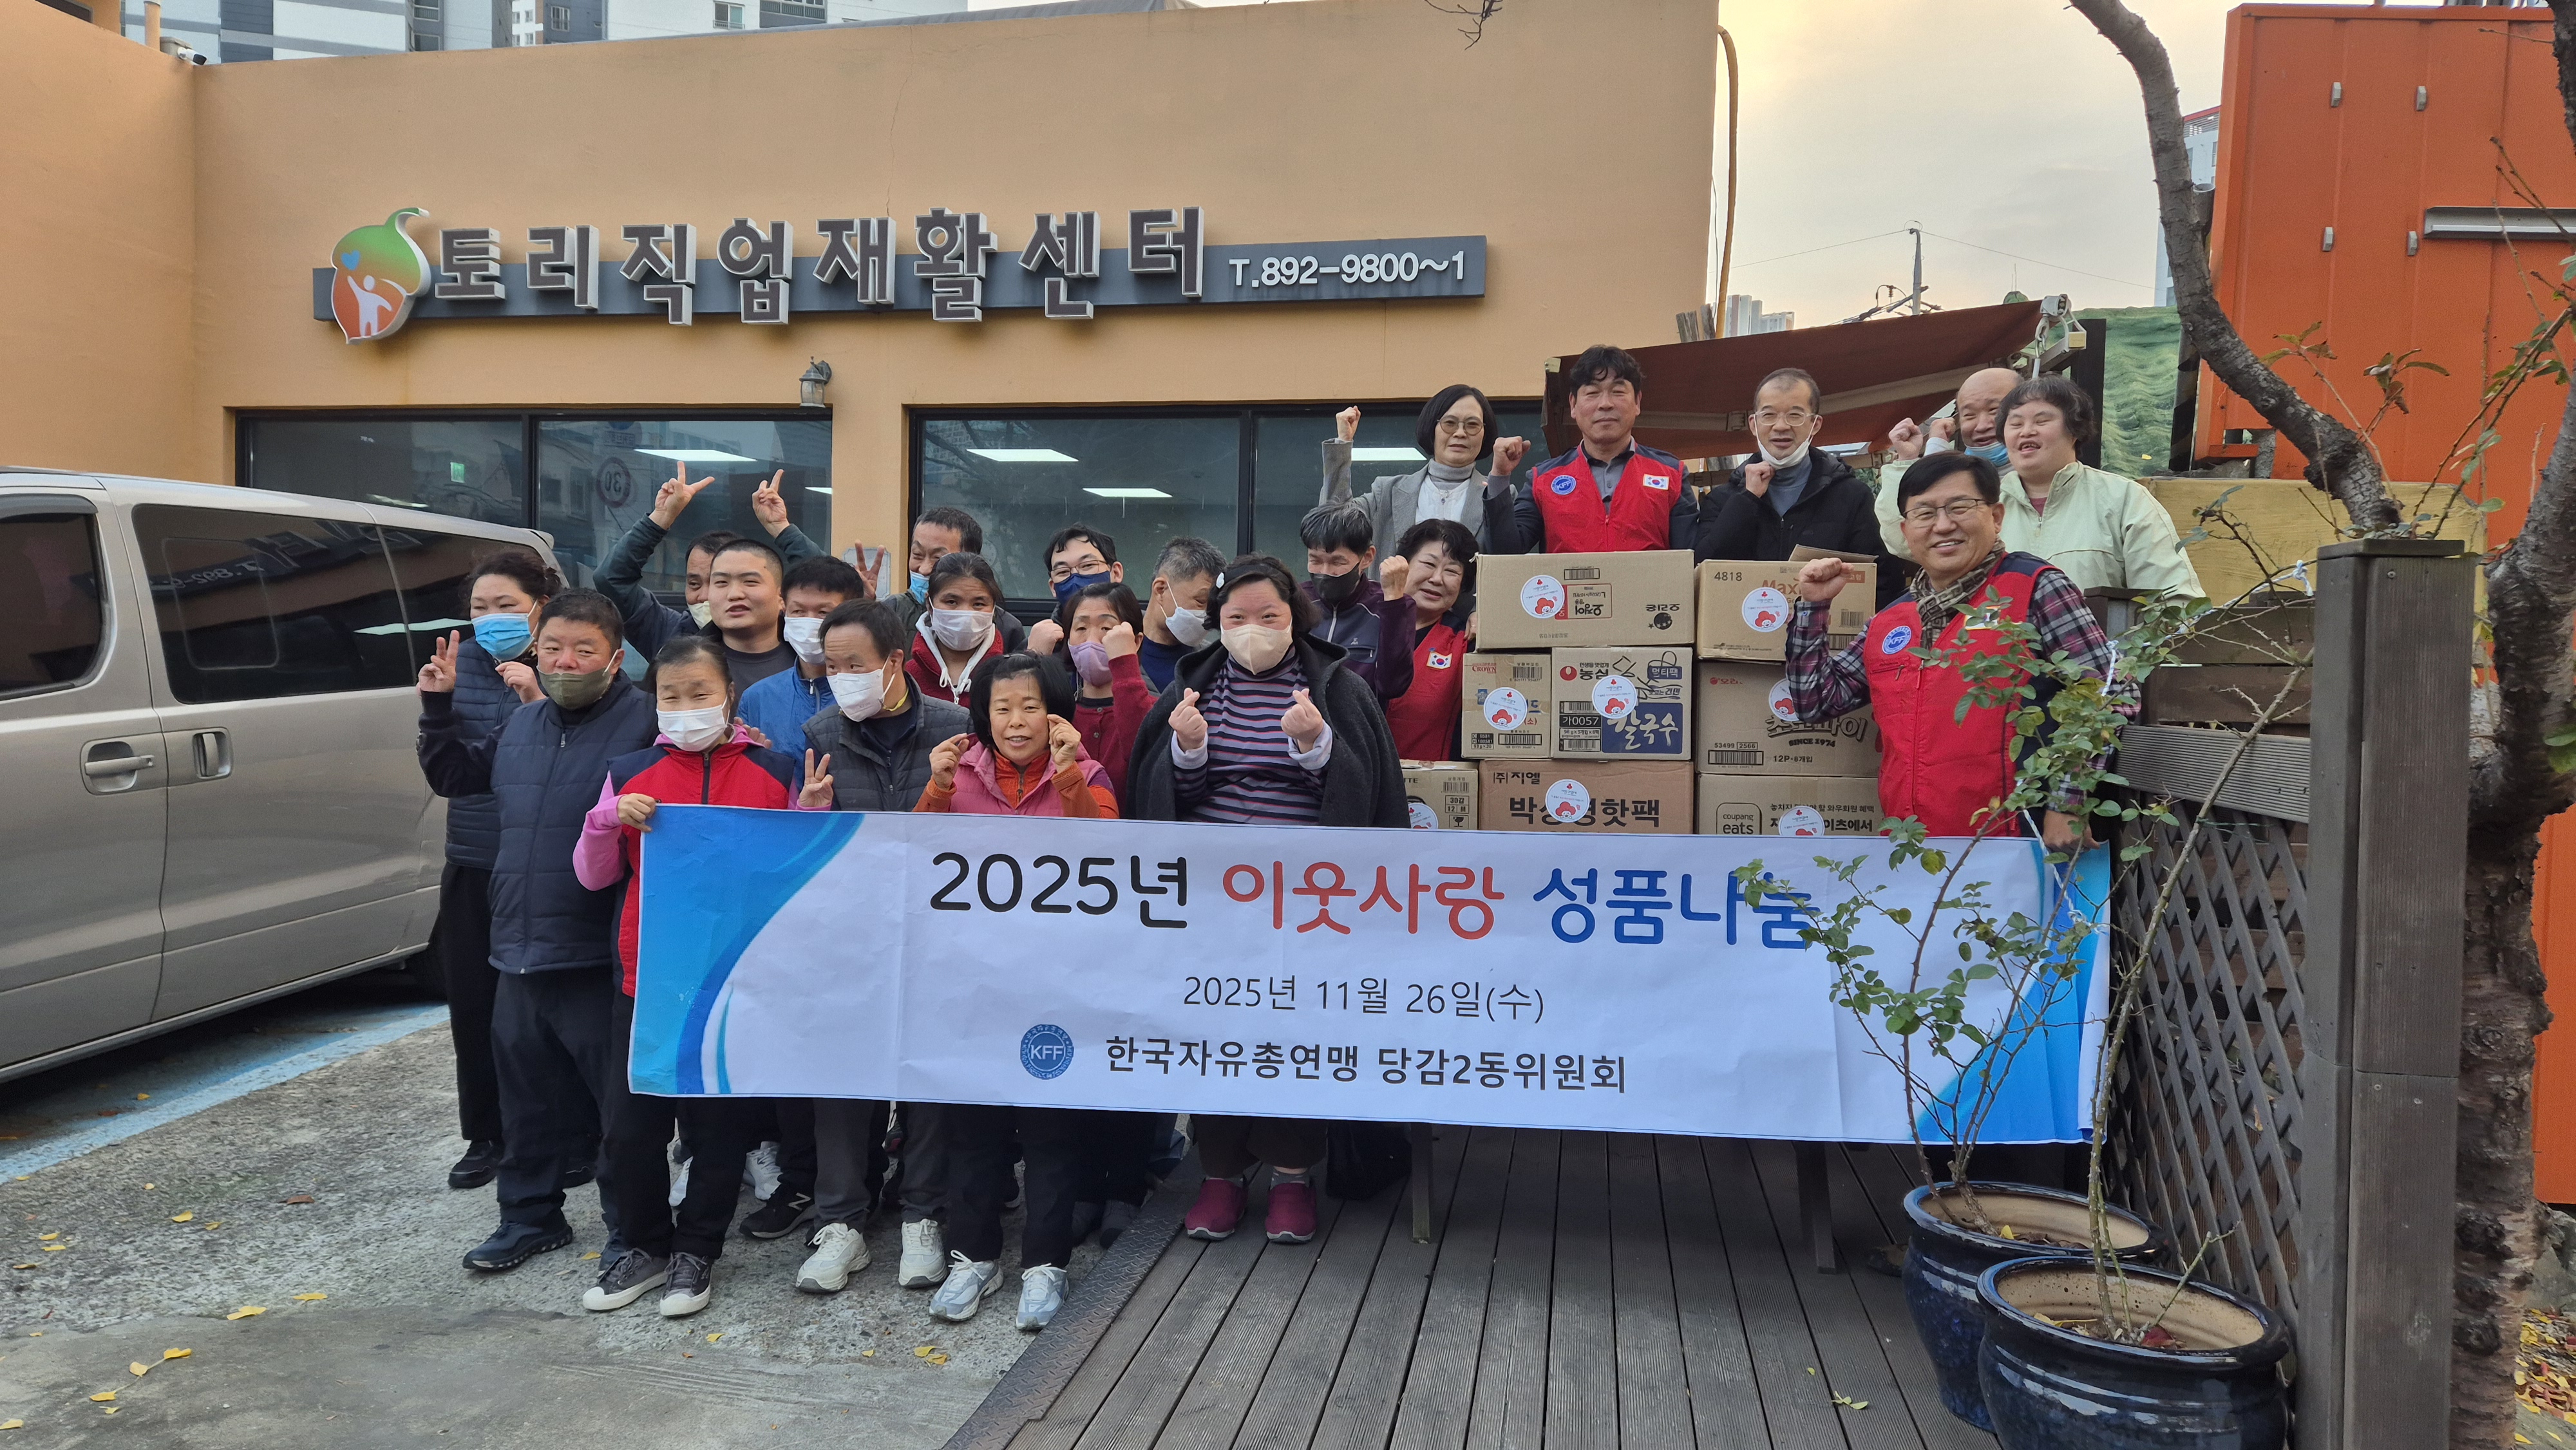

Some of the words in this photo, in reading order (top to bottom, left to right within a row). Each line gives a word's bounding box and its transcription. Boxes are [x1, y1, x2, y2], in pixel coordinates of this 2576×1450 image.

[434, 206, 1204, 326] 토리직업재활센터
[1229, 250, 1464, 288] T.892-9800~1
[1556, 480, 1571, 490] KFF
[1714, 572, 1743, 581] 4818
[1575, 604, 1604, 616] 오징어
[1645, 603, 1681, 612] 오리온
[1888, 636, 1905, 646] KFF
[1579, 668, 1609, 681] 농심
[1524, 717, 1537, 726] (소)
[1562, 715, 1599, 726] 가0057
[1788, 738, 1814, 747] SINCE
[1814, 738, 1835, 748] 1974
[1723, 813, 1754, 822] coupang
[1722, 822, 1754, 835] eats
[1824, 818, 1873, 832] 이츠에서
[930, 852, 1188, 929] 2025년
[1222, 861, 1506, 941] 이웃사랑
[1533, 868, 1821, 950] 성품나눔
[1184, 975, 1297, 1012] 2025년
[1317, 978, 1388, 1015] 11월
[1406, 982, 1544, 1024] 26일(수)
[1030, 1045, 1063, 1060] KFF
[1106, 1035, 1359, 1082] 한국자유총연맹
[1378, 1048, 1626, 1094] 당감2동위원회
